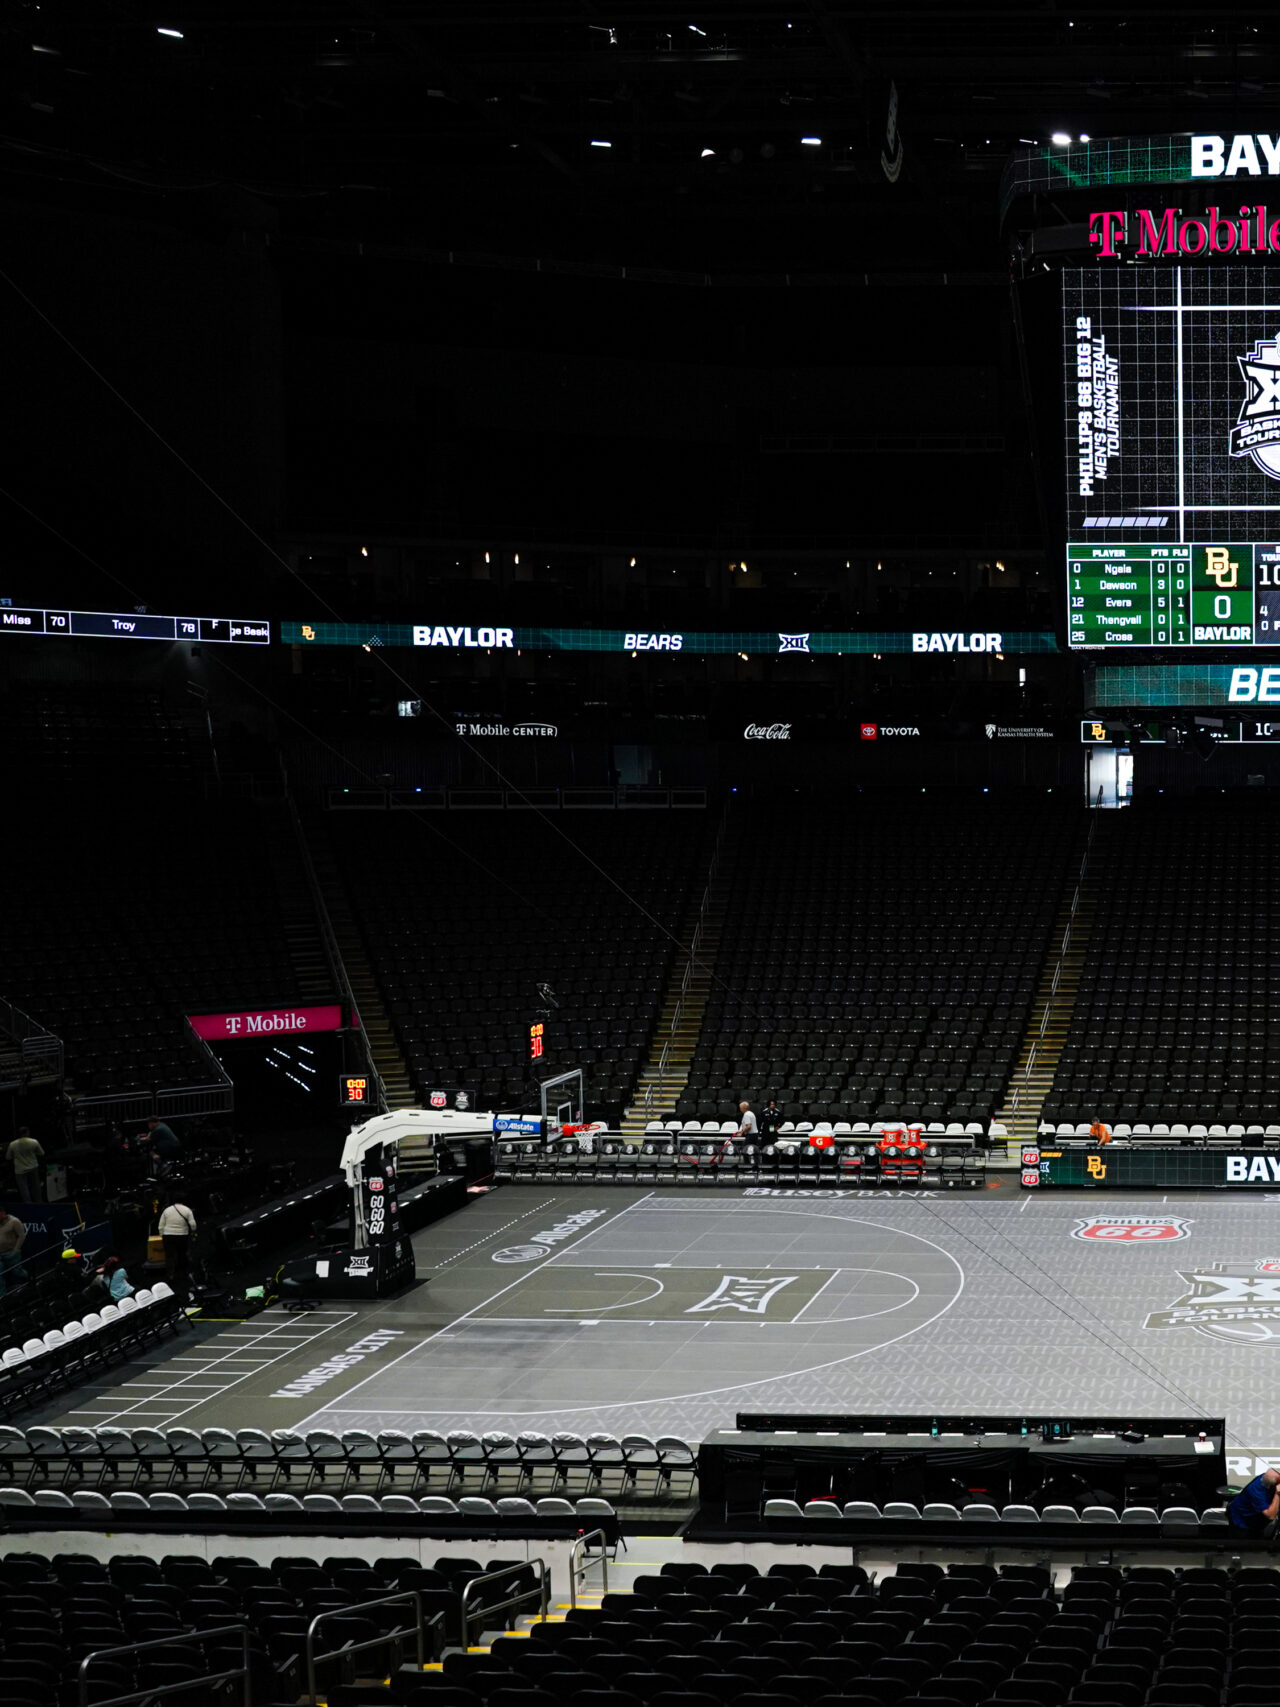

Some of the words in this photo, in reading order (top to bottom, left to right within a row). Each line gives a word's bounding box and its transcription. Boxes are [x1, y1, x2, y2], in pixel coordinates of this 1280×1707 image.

[1089, 211, 1128, 258] T
[1076, 317, 1091, 339] 12
[1077, 343, 1092, 377] BIG
[1092, 334, 1105, 430] BASKETBALL
[1078, 382, 1092, 407] 66
[1106, 354, 1120, 457] TOURNAMENT
[1079, 411, 1094, 496] PHILLIPS
[1094, 432, 1107, 479] MEN'S
[1092, 549, 1126, 557] PLAYER
[1151, 549, 1169, 557] PTS
[1073, 563, 1081, 574] 0
[1074, 580, 1081, 590] 1
[1157, 580, 1165, 590] 3
[1071, 597, 1085, 608] 12
[1157, 597, 1165, 608] 5
[1214, 595, 1231, 619] 0
[1259, 605, 1268, 616] 4
[3, 615, 31, 626] Miss
[50, 616, 65, 627] 70
[112, 619, 136, 633] Troy
[181, 623, 195, 633] 78
[1071, 614, 1085, 625] 21
[1261, 620, 1269, 631] 0
[413, 626, 514, 649] BAYLOR
[1071, 631, 1086, 642] 25
[1105, 632, 1133, 642] Cross
[1194, 626, 1251, 641] BAYLOR
[623, 634, 683, 651] BEARS
[912, 633, 1002, 652] BAYLOR
[456, 723, 467, 735] T
[469, 723, 510, 736] Mobile
[512, 727, 554, 736] CENTER
[880, 727, 920, 736] TOYOTA
[225, 1016, 241, 1034] T
[246, 1013, 307, 1033] Mobile
[530, 1037, 543, 1058] 30
[346, 1078, 366, 1088] 10:00
[348, 1089, 363, 1100] 30
[508, 1121, 534, 1132] Allstate
[816, 1138, 823, 1146] G
[750, 1186, 860, 1199] Busey
[858, 1189, 940, 1198] BANK
[370, 1195, 384, 1208] GO
[371, 1208, 385, 1221] GO
[369, 1221, 384, 1234] GO
[530, 1207, 606, 1245] Allstate
[1095, 1226, 1167, 1237] 66
[268, 1350, 366, 1399] KANSAS
[348, 1328, 406, 1354] CITY
